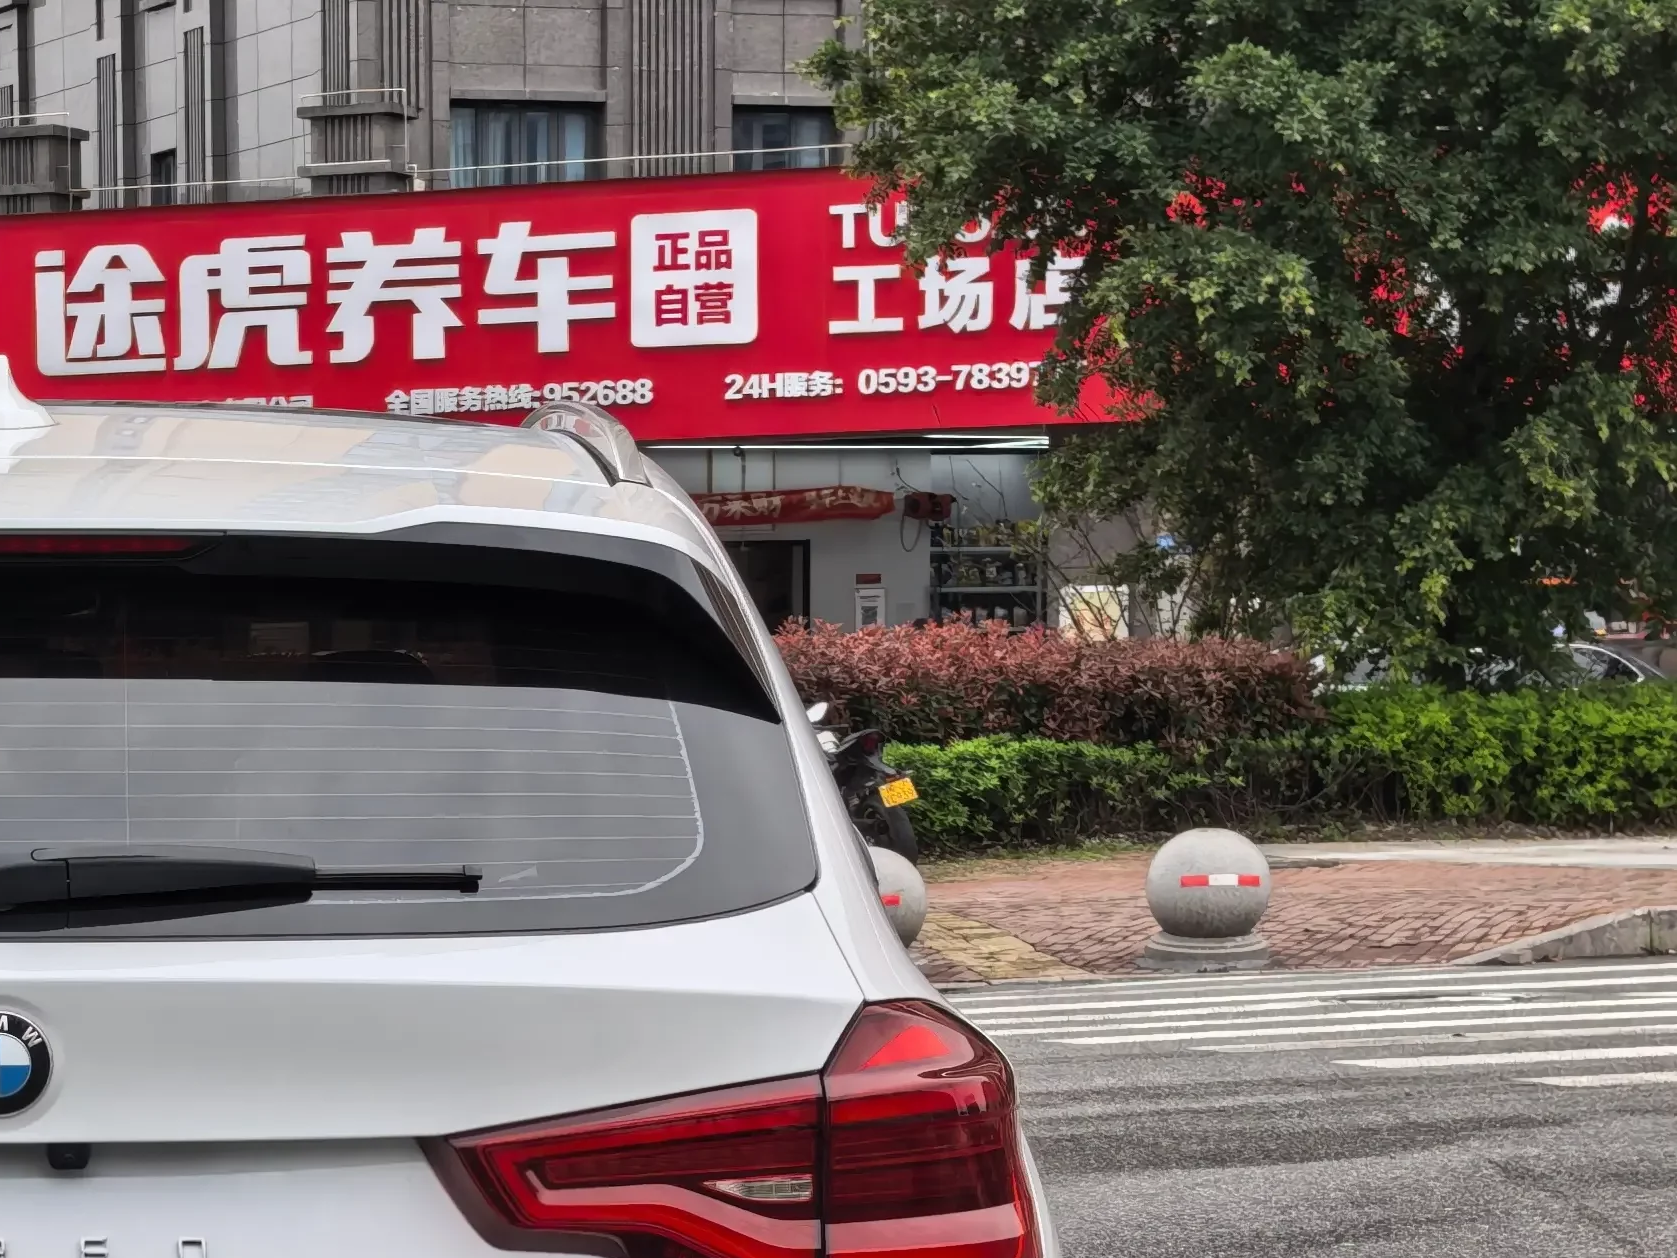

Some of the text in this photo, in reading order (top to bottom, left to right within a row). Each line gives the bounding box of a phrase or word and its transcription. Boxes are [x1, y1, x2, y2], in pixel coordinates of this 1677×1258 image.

[652, 229, 733, 272] 正品
[35, 221, 616, 376] 途虎养车
[654, 281, 734, 327] 自营
